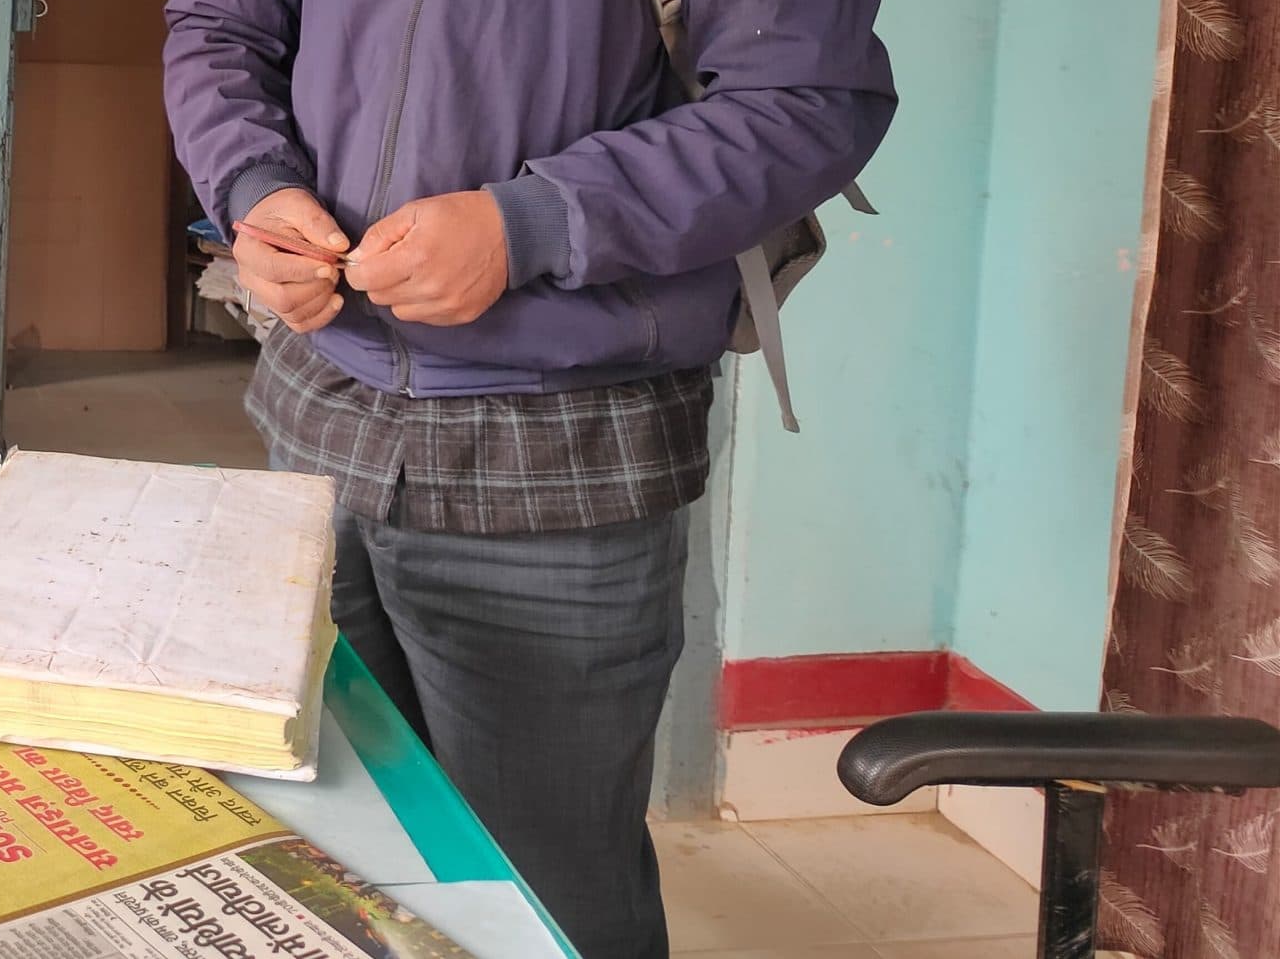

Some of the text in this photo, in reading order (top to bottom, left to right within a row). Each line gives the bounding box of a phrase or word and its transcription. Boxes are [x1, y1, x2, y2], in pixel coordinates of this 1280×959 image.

[37, 766, 99, 805] बिहार
[140, 772, 172, 788] बने
[185, 777, 224, 798] और
[164, 788, 218, 821] चिकन
[216, 798, 262, 826] स्वाद
[86, 804, 143, 841] स्वाद
[139, 878, 179, 901] के
[176, 863, 286, 938] लाठीचार्ज
[139, 914, 160, 926] को
[265, 933, 304, 953] में
